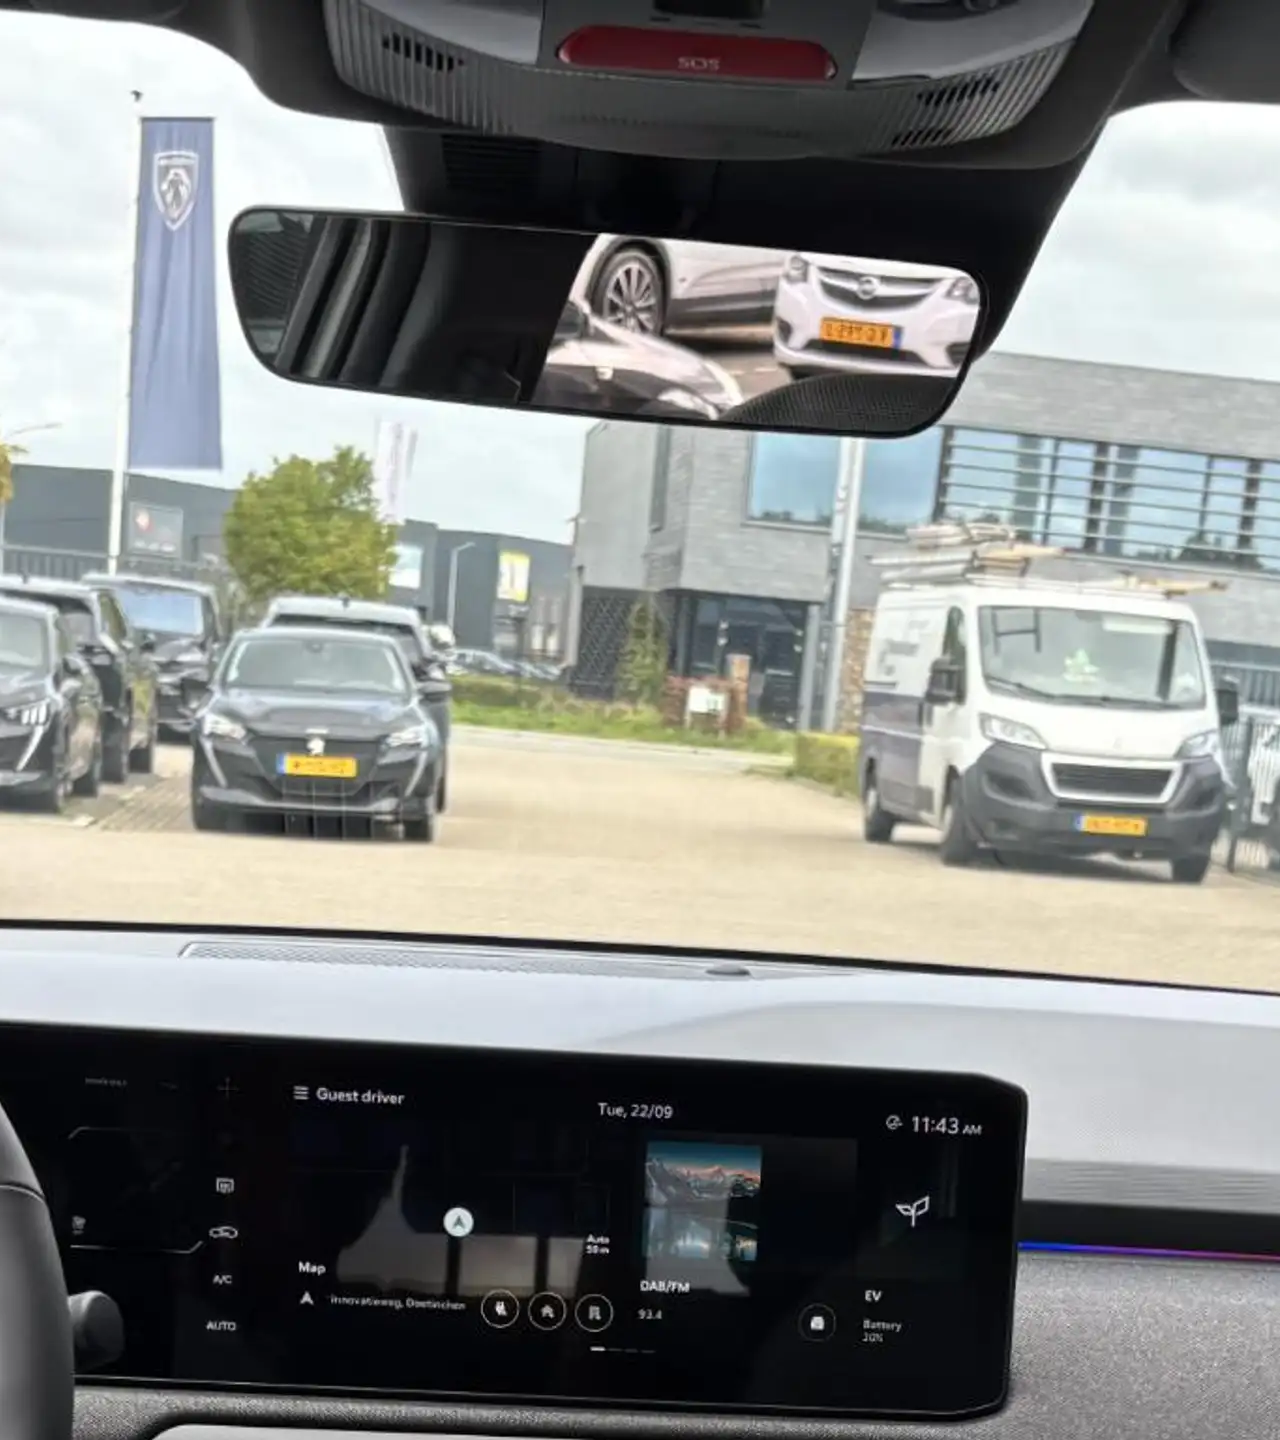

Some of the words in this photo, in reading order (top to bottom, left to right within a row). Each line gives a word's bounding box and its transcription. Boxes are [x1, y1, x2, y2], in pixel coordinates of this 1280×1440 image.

[677, 56, 721, 71] SOS
[316, 1087, 359, 1102] Guest
[361, 1089, 405, 1105] driver
[597, 1102, 628, 1119] Tue,
[630, 1104, 673, 1119] 22/09
[911, 1116, 960, 1135] 11:43
[962, 1124, 982, 1135] AM
[298, 1262, 327, 1275] Map
[212, 1274, 232, 1285] A/C
[639, 1280, 690, 1294] DAB/FM
[864, 1289, 882, 1302] EV
[206, 1320, 237, 1331] AUTO
[862, 1319, 902, 1333] Battery
